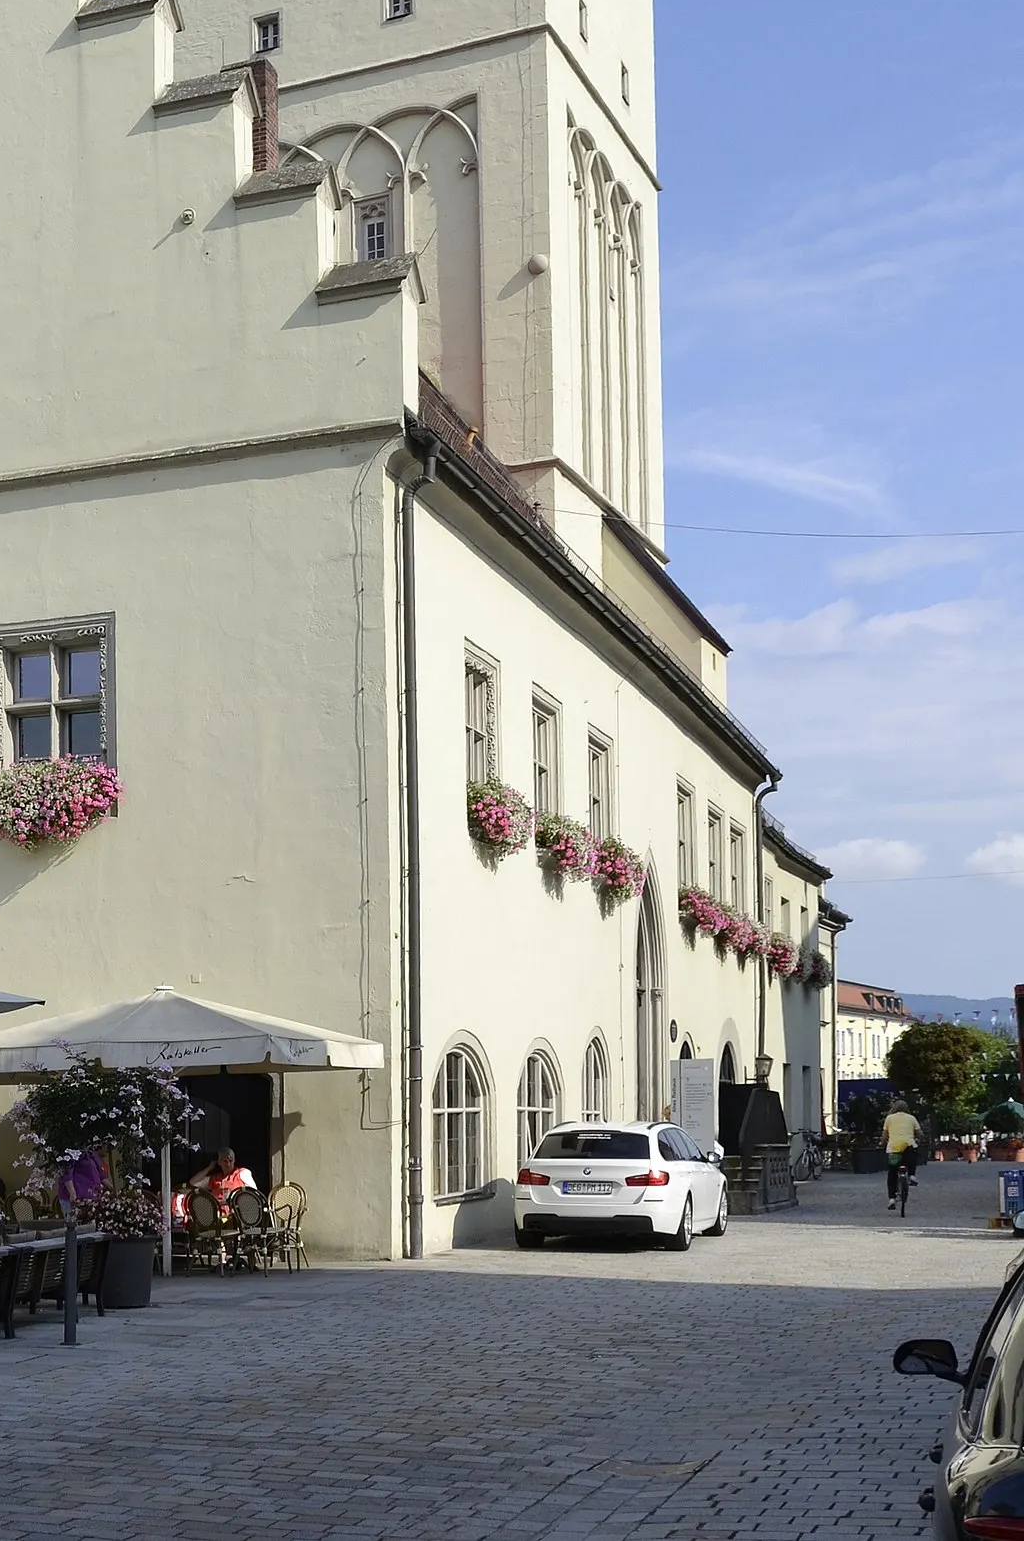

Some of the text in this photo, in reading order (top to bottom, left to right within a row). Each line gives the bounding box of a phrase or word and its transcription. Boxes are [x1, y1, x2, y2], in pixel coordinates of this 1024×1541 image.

[146, 1042, 222, 1065] Ratskeller
[568, 1182, 611, 1192] DEG PM 112
